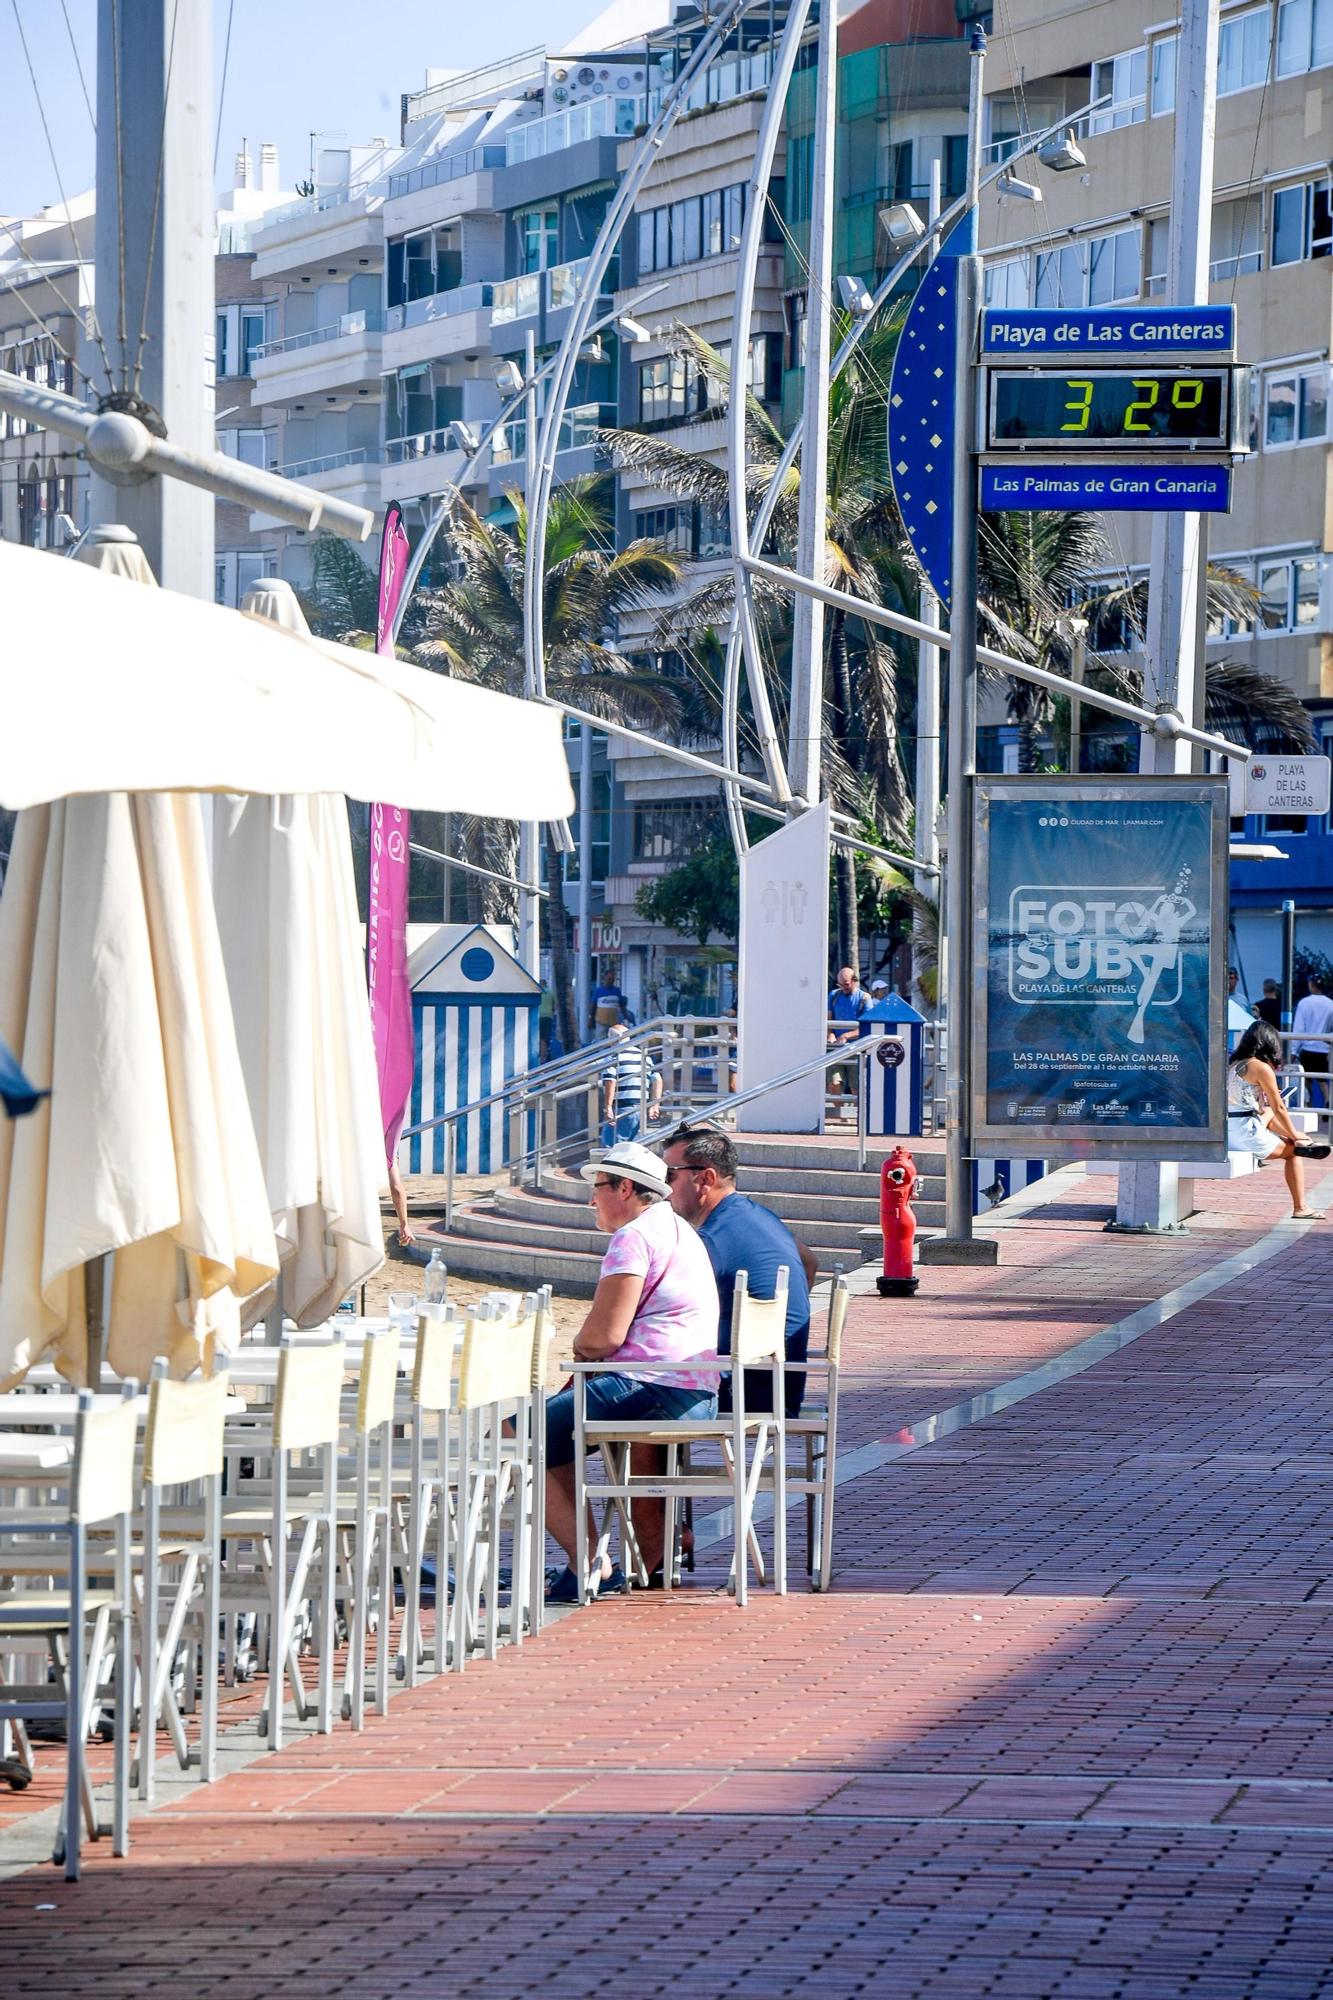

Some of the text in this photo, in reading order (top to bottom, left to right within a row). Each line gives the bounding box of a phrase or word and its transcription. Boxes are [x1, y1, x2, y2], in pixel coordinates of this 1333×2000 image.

[990, 322, 1224, 347] Playa de Las Canteras
[993, 477, 1217, 493] Las Palmas de Gran Canaria
[1279, 764, 1305, 776] PLAYA
[1276, 780, 1306, 791] DE LAS
[1268, 796, 1313, 807] CANTERAS
[1018, 901, 1150, 937] FOTO
[1016, 939, 1133, 979] SUB
[1018, 984, 1137, 994] PLAYA DE LAS CANTERAS
[1013, 1053, 1180, 1063] LAS PALMAS DE GRAN CANARIA
[1050, 1063, 1092, 1071] septiembre
